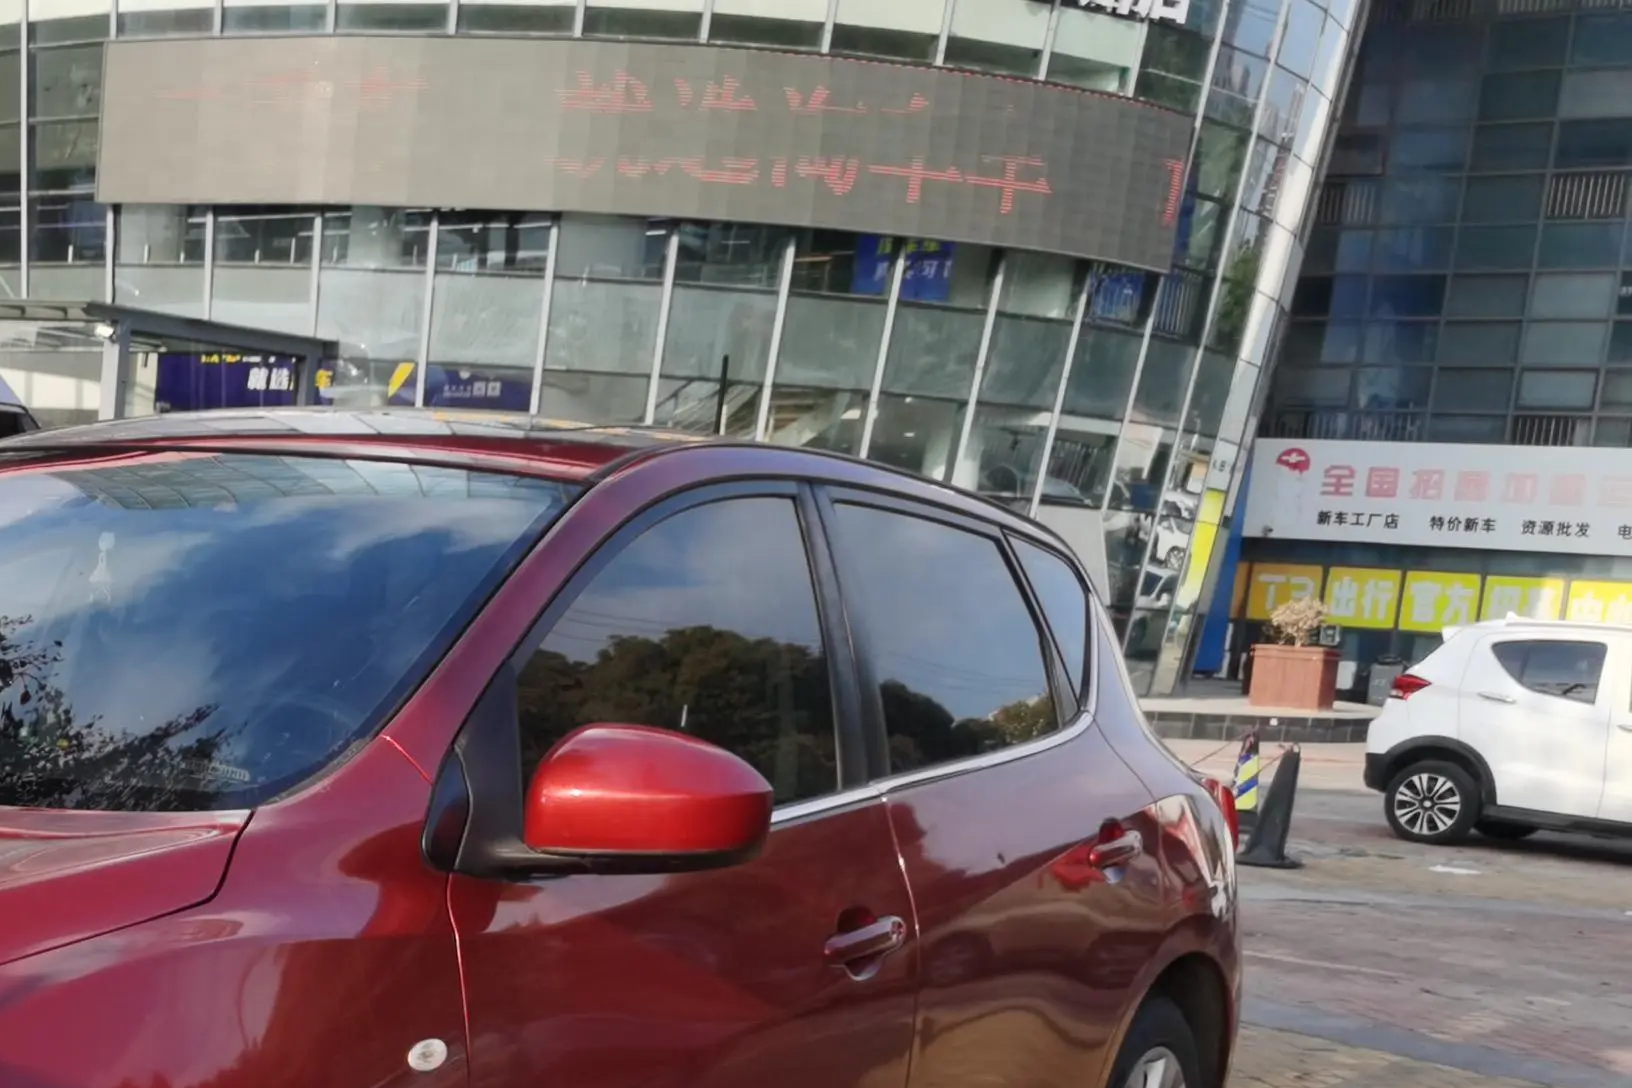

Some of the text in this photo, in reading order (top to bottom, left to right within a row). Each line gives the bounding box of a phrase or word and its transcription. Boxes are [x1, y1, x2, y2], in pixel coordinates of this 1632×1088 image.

[1317, 510, 1400, 530] 新车工厂店
[1430, 515, 1497, 533] 特价新车
[1521, 519, 1591, 539] 资源批发
